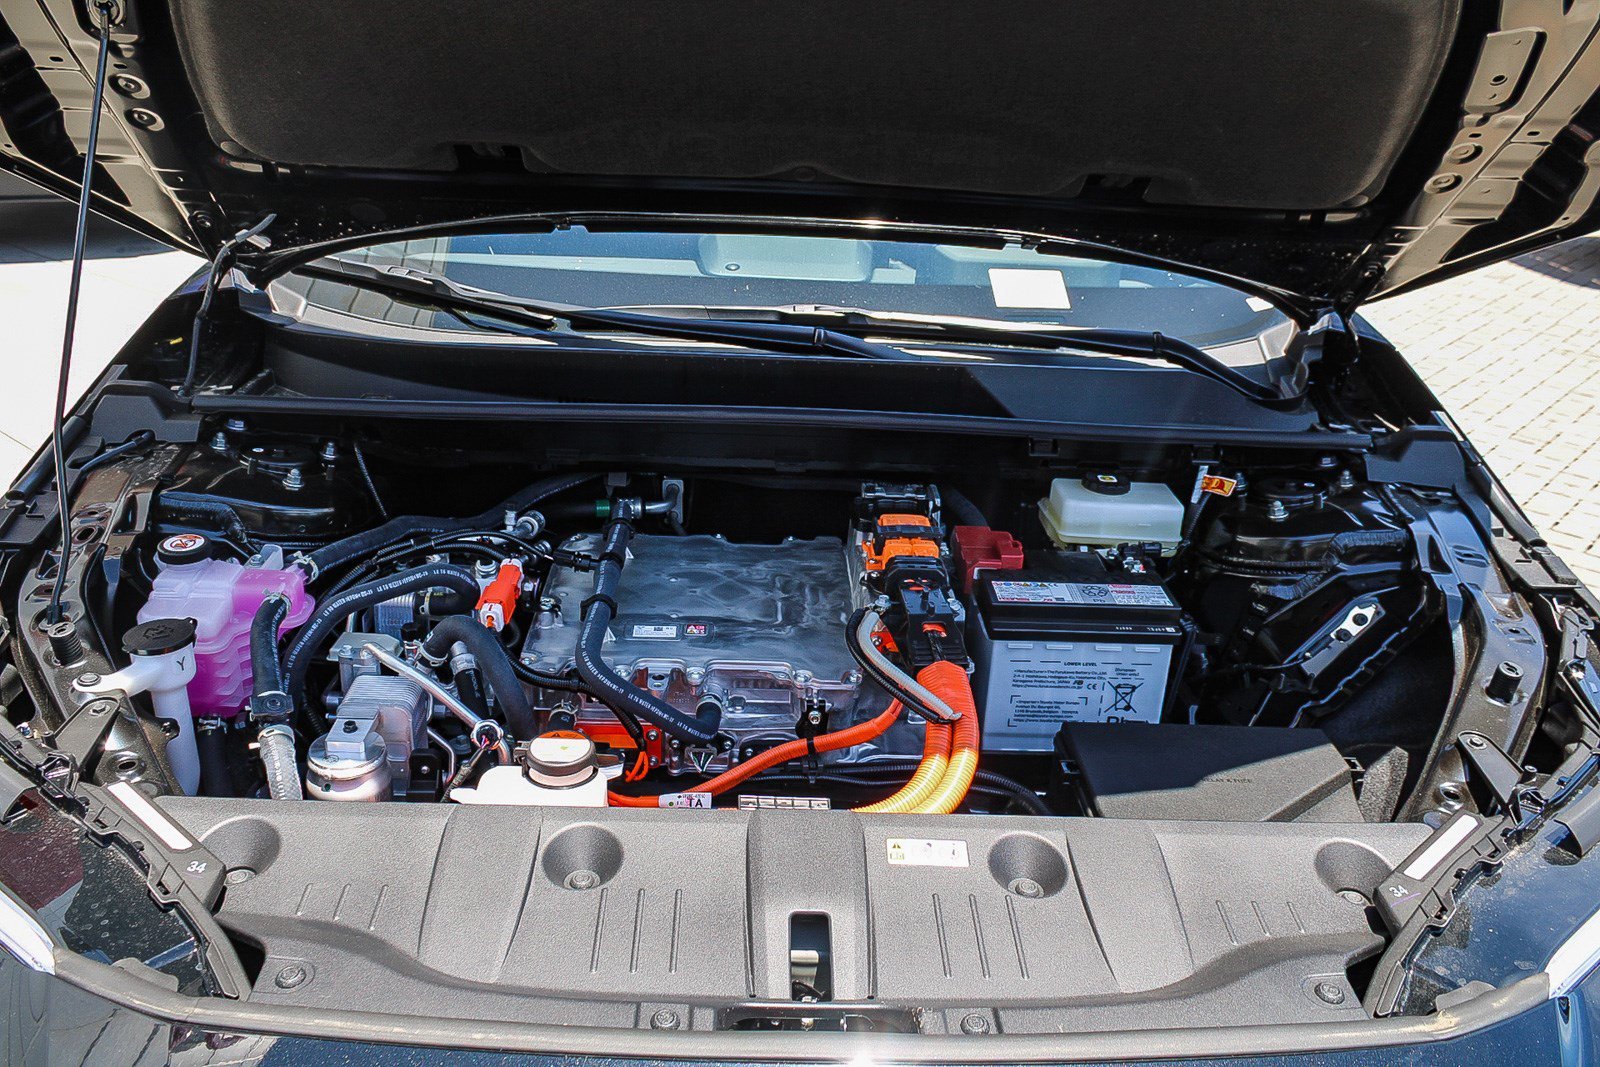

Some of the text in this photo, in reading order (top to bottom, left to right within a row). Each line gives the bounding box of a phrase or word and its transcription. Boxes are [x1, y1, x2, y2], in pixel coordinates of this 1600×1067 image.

[176, 655, 186, 671] Y
[688, 798, 703, 808] TA
[186, 860, 207, 874] 34
[1388, 884, 1409, 898] 34
